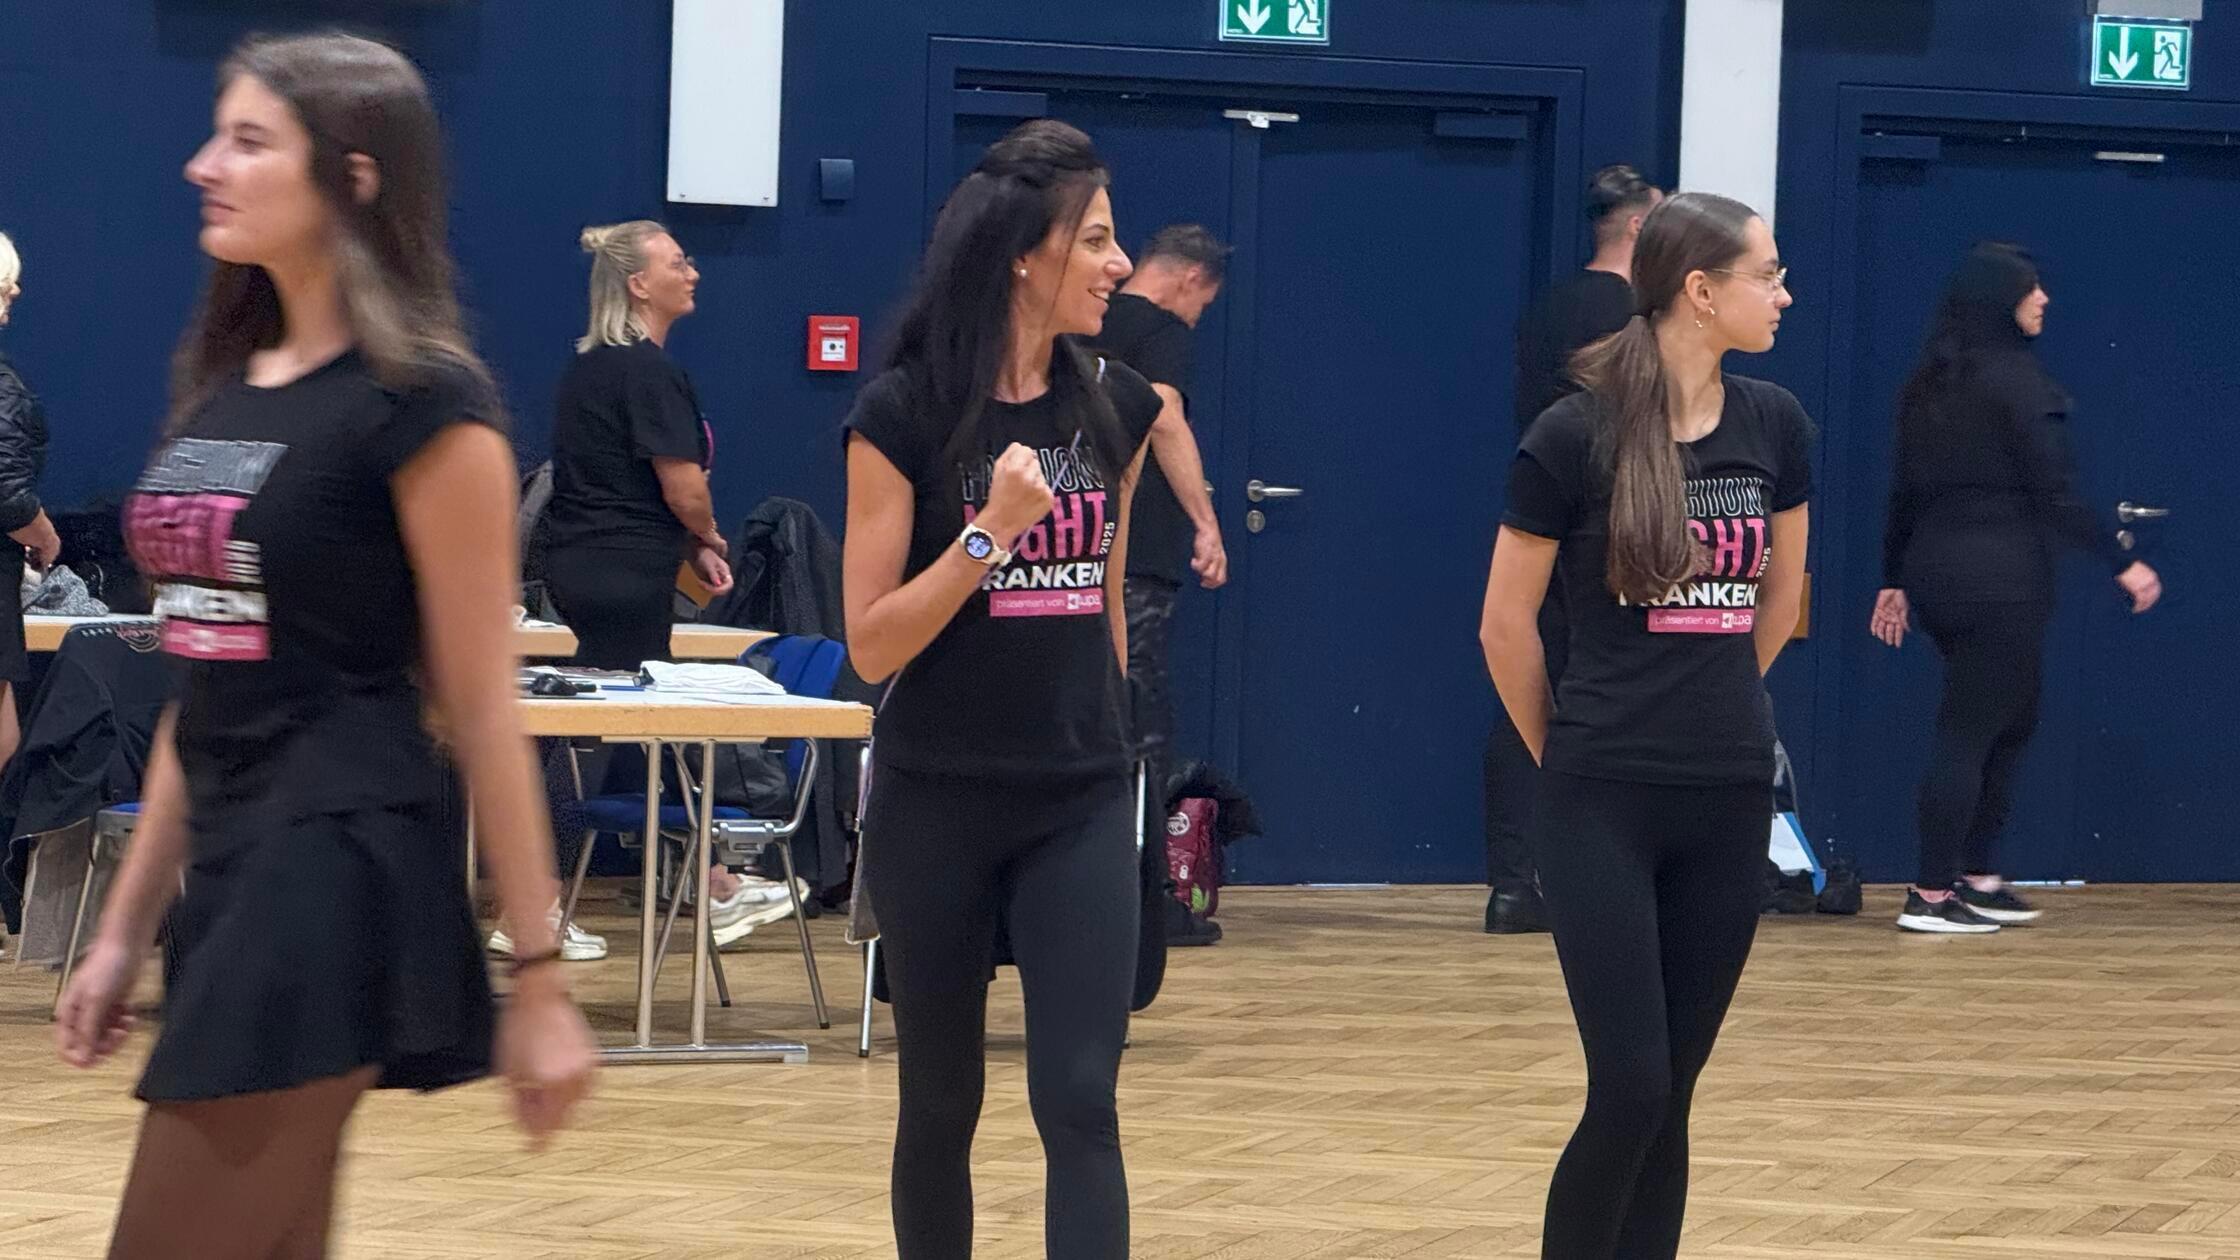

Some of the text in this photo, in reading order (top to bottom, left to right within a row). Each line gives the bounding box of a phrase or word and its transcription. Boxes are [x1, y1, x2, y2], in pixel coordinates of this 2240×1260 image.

[1099, 521, 1116, 556] 2025
[981, 561, 1105, 591] RANKEN
[1046, 598, 1065, 607] von
[1619, 582, 1759, 607] ANKEN
[1704, 617, 1720, 625] von
